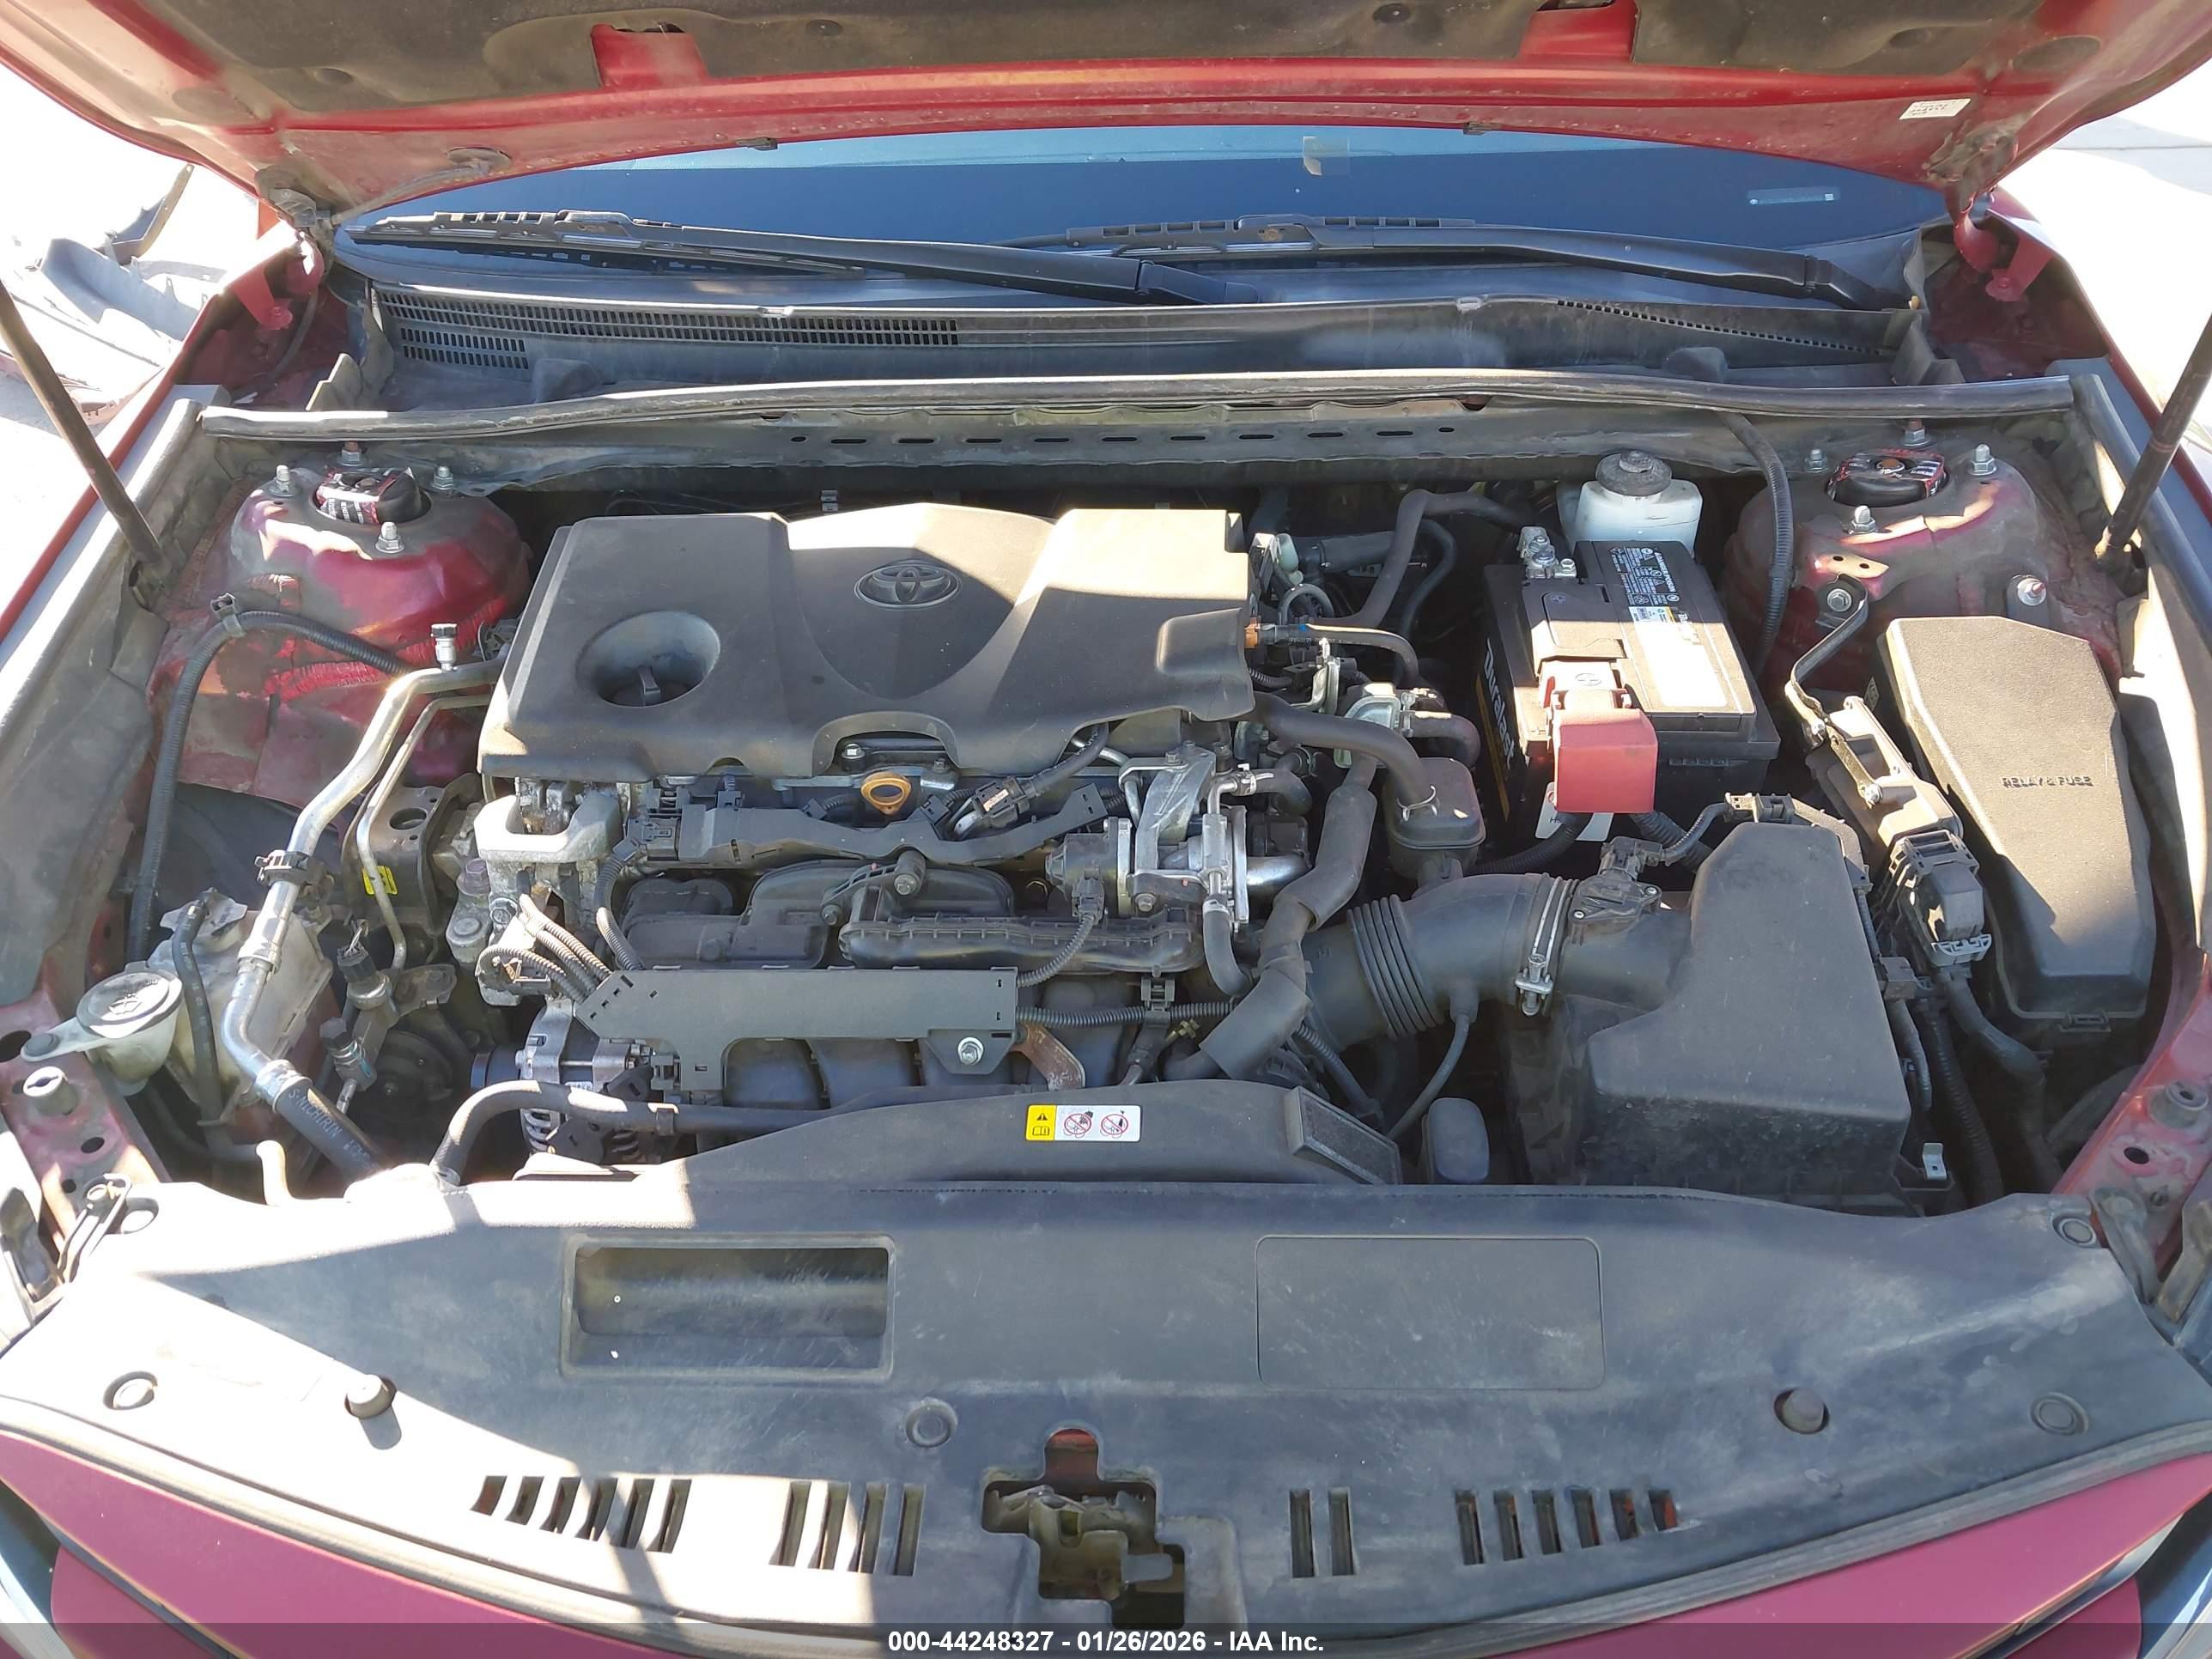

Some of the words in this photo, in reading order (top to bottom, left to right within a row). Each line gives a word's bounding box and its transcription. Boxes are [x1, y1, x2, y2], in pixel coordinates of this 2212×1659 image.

[1484, 638, 1515, 770] Duralast
[2001, 775, 2044, 788] RELAY
[2057, 775, 2094, 787] FUSE
